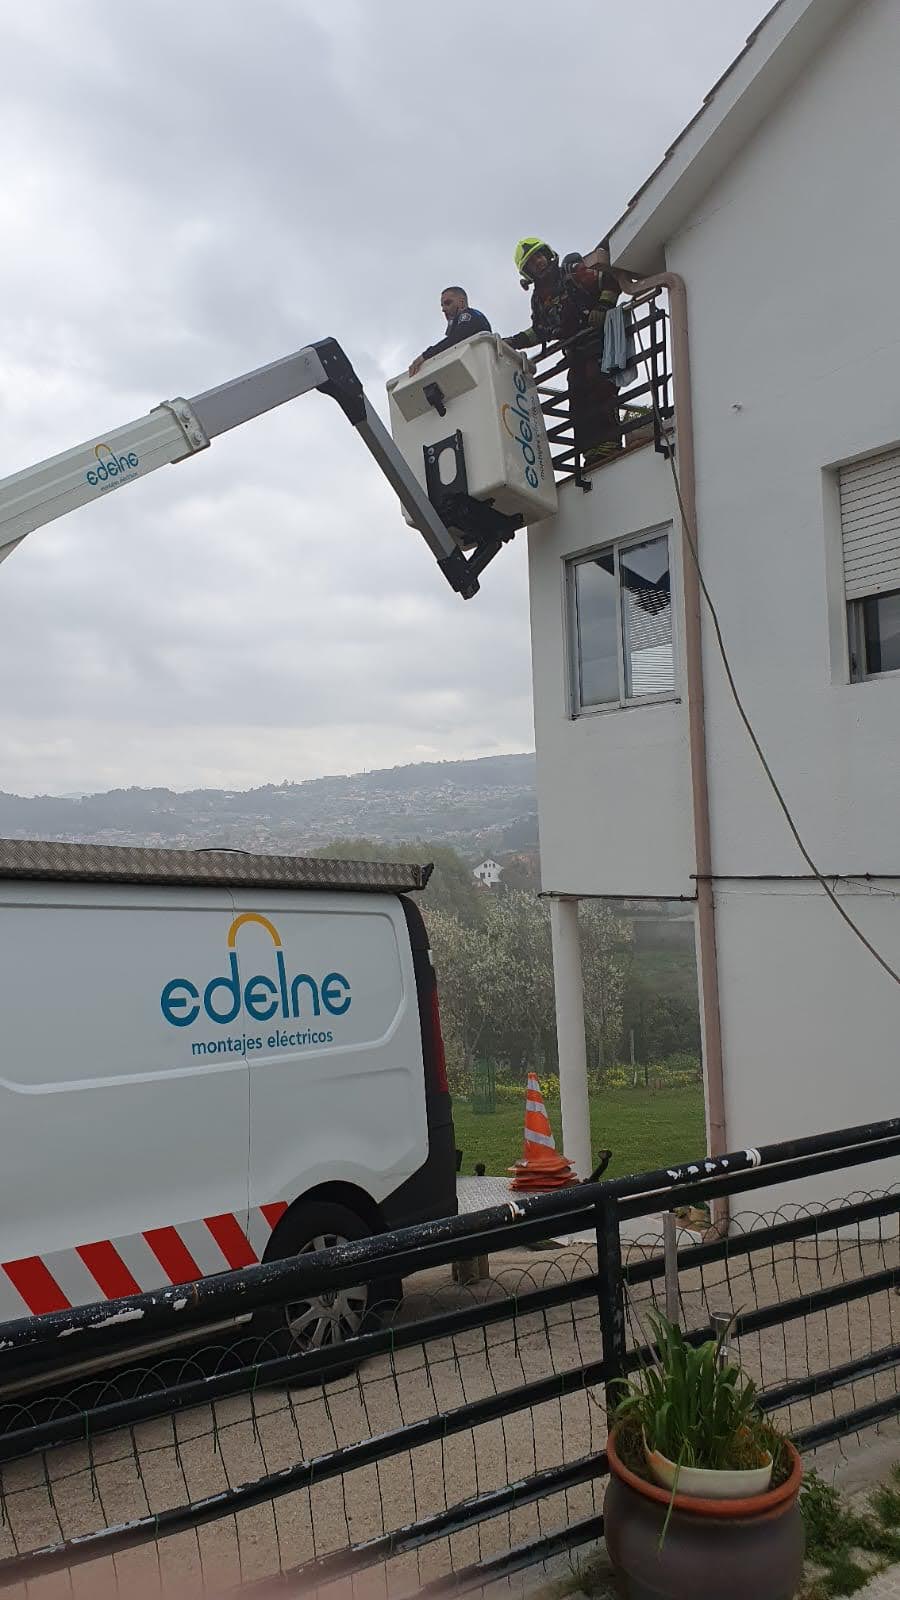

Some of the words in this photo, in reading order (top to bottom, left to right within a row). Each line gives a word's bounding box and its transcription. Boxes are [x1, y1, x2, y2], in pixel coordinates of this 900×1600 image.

[510, 370, 539, 489] edelne
[86, 452, 139, 486] edelne
[160, 950, 352, 1028] edelne
[191, 1033, 263, 1056] montajes
[267, 1028, 334, 1048] eléctricos
